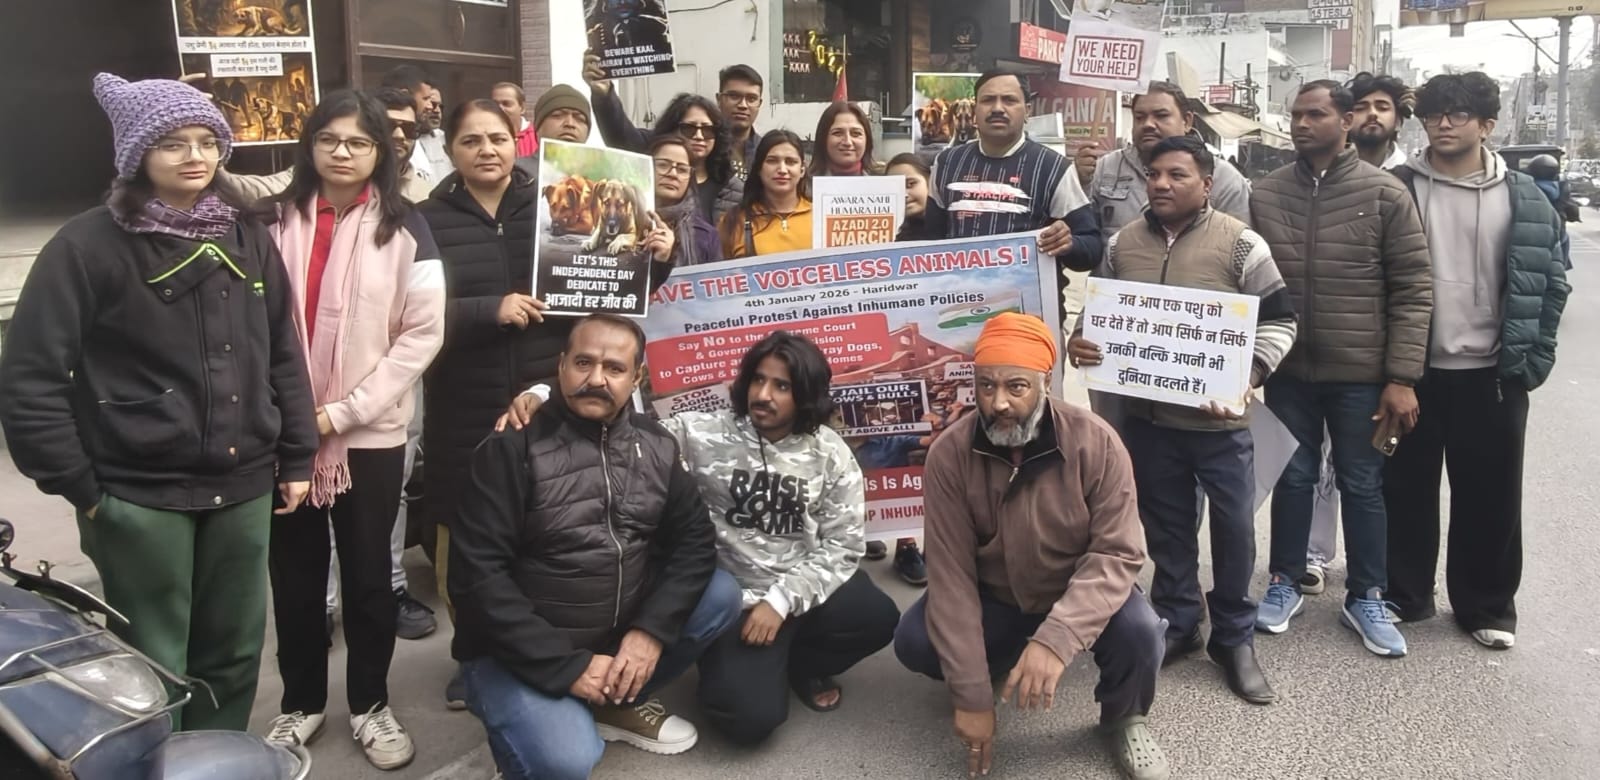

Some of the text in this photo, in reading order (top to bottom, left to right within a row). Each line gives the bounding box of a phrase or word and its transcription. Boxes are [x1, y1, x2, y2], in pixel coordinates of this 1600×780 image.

[1323, 8, 1352, 17] TESLA
[604, 45, 655, 57] BEWARE KAAL
[1038, 37, 1058, 63] PARK
[1078, 40, 1098, 58] WE
[1102, 42, 1137, 60] NEED
[624, 57, 632, 65] IS
[633, 53, 672, 64] WATCHING
[611, 65, 655, 76] EVERYTHING
[1076, 59, 1136, 76] YOUR HELP
[831, 196, 890, 205] AWARA NAHI
[831, 206, 890, 214] HUMARA HAI
[832, 218, 888, 232] AZADI 2.0
[831, 230, 890, 246] MARCH
[573, 254, 618, 267] LET'S THIS
[552, 266, 635, 280] INDEPENDENCE DAY
[650, 282, 696, 304] AVE
[700, 274, 750, 298] THE
[754, 258, 893, 290] VOICELESS
[898, 247, 1013, 276] ANIMALS
[566, 280, 620, 292] DEDICATE TO
[545, 292, 638, 310] आजादी हर जीव की
[744, 298, 765, 309] 4th
[768, 293, 816, 307] January
[820, 288, 850, 300] 2026
[862, 282, 919, 296] Haridwar
[684, 290, 984, 333] Peaceful Protest Against Inhumane Policies
[1118, 292, 1223, 320] जब आप एक पशु को
[678, 342, 700, 352] Say
[704, 336, 726, 348] No
[730, 336, 742, 344] to
[745, 333, 764, 342] the
[823, 322, 856, 332] Court
[1091, 314, 1248, 348] घर देते हैं तो आप सिर्फ न सिर्फ
[811, 336, 843, 344] ision
[696, 352, 704, 360] &
[820, 342, 882, 355] ray Dogs,
[1106, 340, 1226, 372] उनकी बल्कि अपनी भी
[660, 370, 672, 379] to
[675, 360, 726, 375] Capture
[682, 372, 714, 384] Cows
[718, 370, 726, 378] &
[1118, 368, 1206, 396] दुनिया बदलते हैं।
[672, 388, 712, 404] STOP
[832, 394, 864, 404] OWS
[878, 390, 919, 400] BULLS
[840, 388, 873, 397] JAIL
[876, 384, 910, 393] OUR
[671, 394, 720, 411] CAGING
[855, 426, 890, 435] ABOVE
[730, 468, 810, 503] RAISE
[882, 475, 897, 490] Is
[731, 488, 806, 514] YOUR
[880, 504, 924, 520] INHUM
[725, 507, 805, 534] GAME
